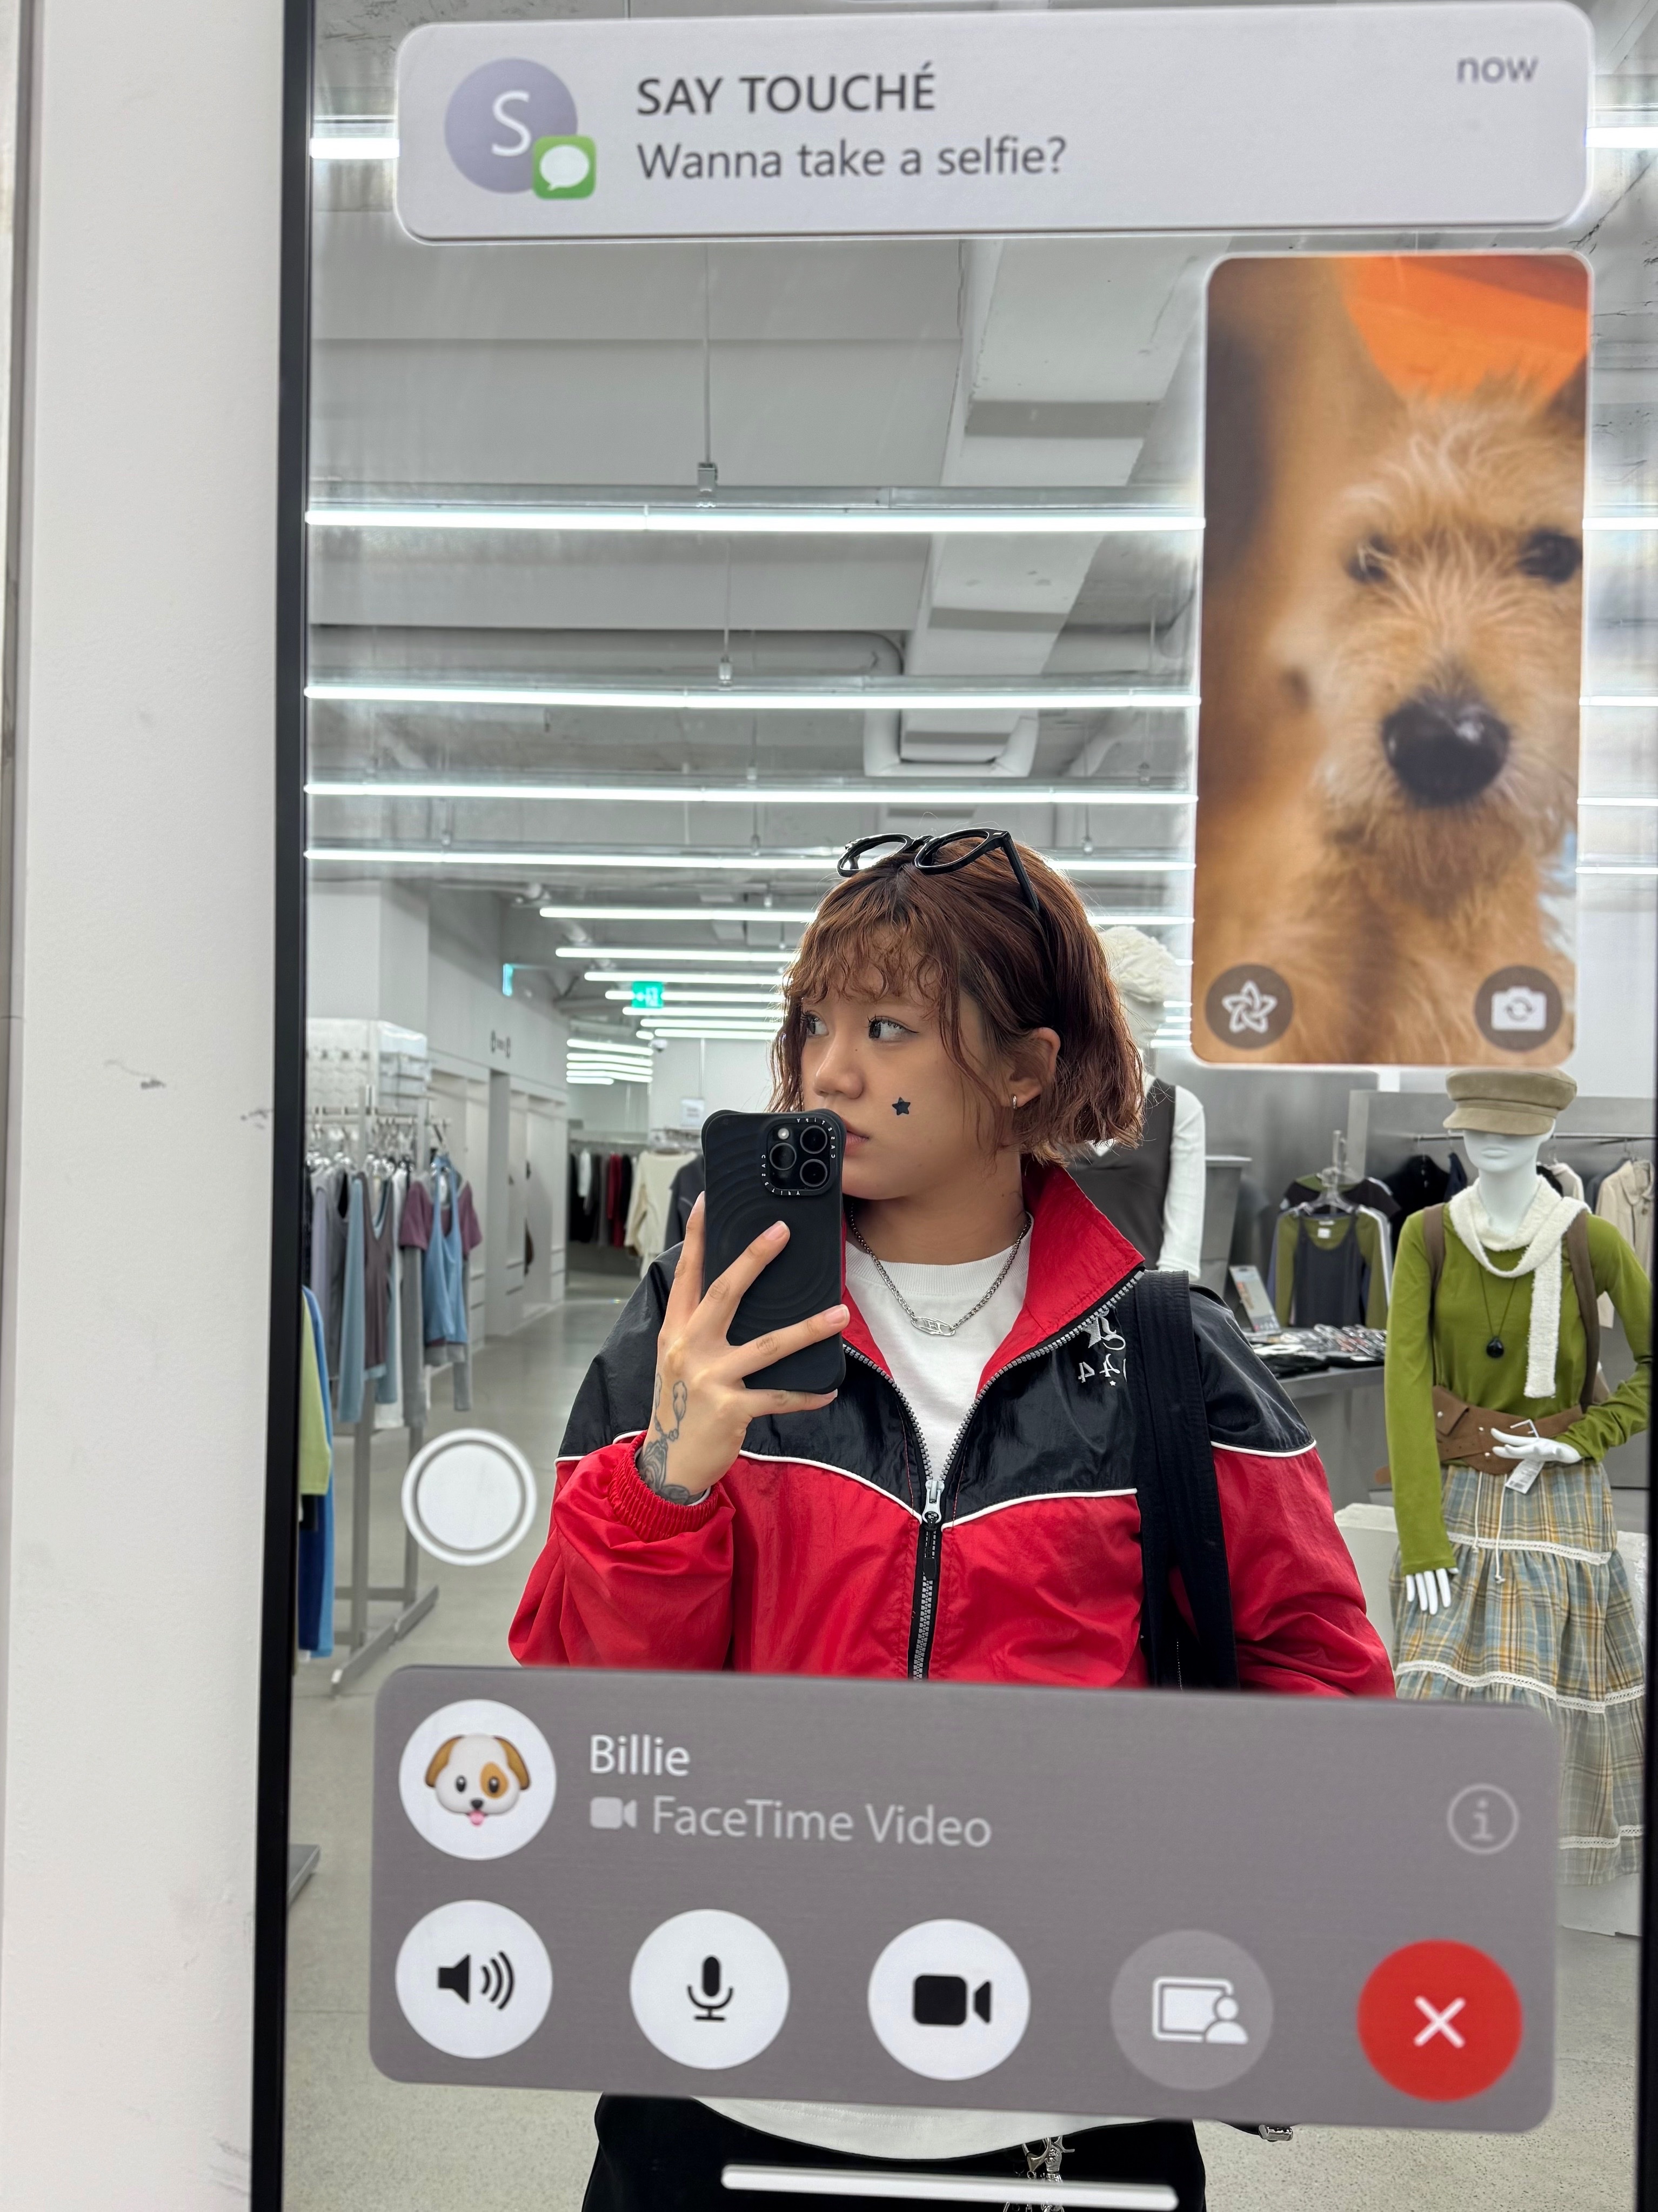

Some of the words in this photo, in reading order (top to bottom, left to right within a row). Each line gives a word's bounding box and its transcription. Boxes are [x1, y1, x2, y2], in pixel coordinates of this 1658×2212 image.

[637, 77, 724, 116] SAY
[738, 61, 936, 114] TOUCHÉ
[1456, 57, 1539, 83] now
[492, 90, 531, 157] S
[636, 143, 782, 180] Wanna
[797, 138, 886, 178] take
[900, 148, 922, 176] a
[938, 135, 1067, 176] selfie?
[590, 1734, 691, 1777] Billie
[653, 1795, 854, 1842] FaceTime
[865, 1803, 992, 1848] Video
